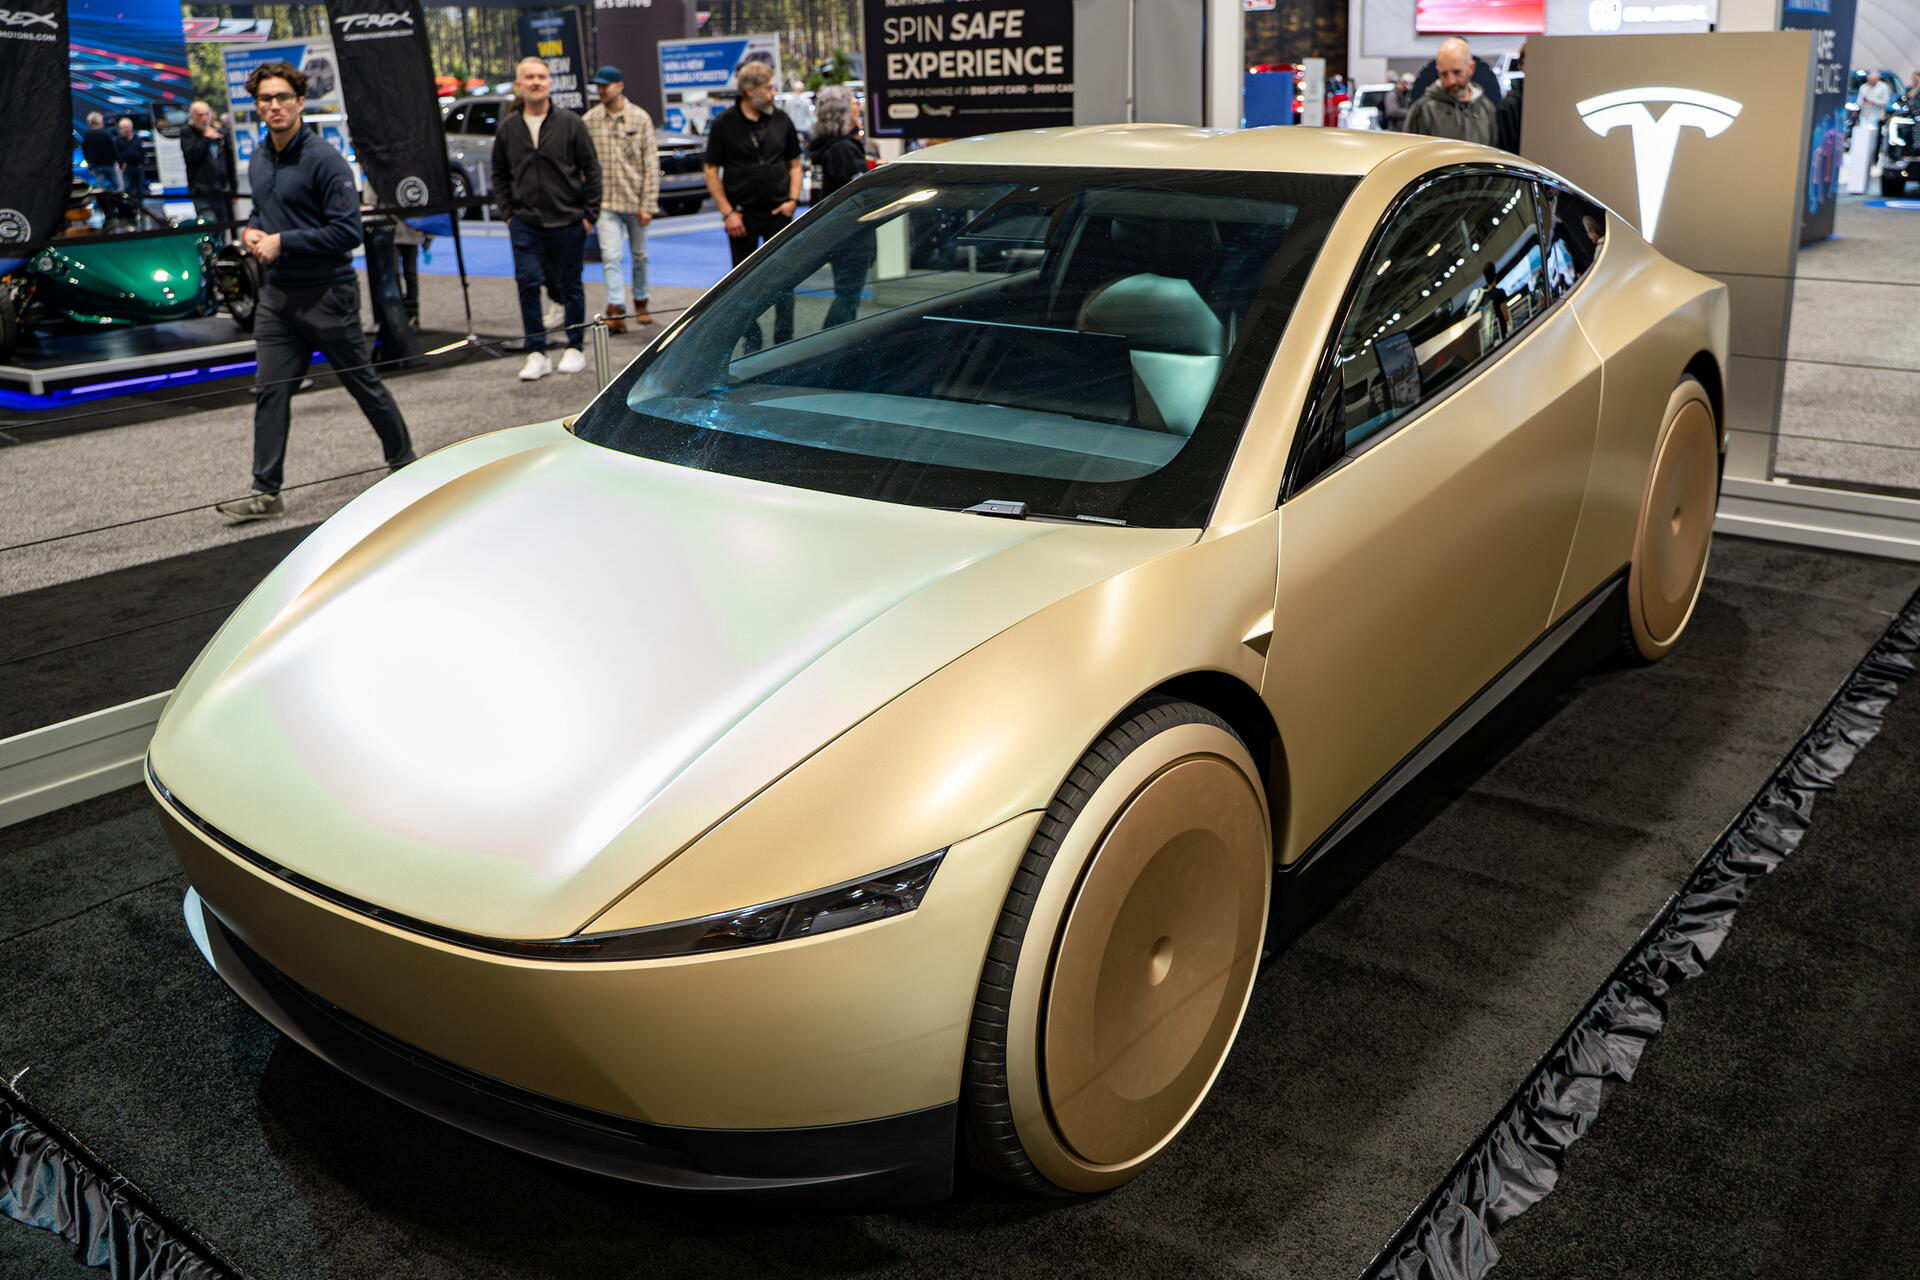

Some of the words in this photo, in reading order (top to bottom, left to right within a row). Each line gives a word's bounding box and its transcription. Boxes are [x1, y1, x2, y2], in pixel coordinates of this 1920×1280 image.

[884, 15, 944, 45] SPIN
[950, 9, 1025, 41] SAFE
[887, 45, 1065, 80] EXPERIENCE
[1056, 83, 1074, 94] CAS
